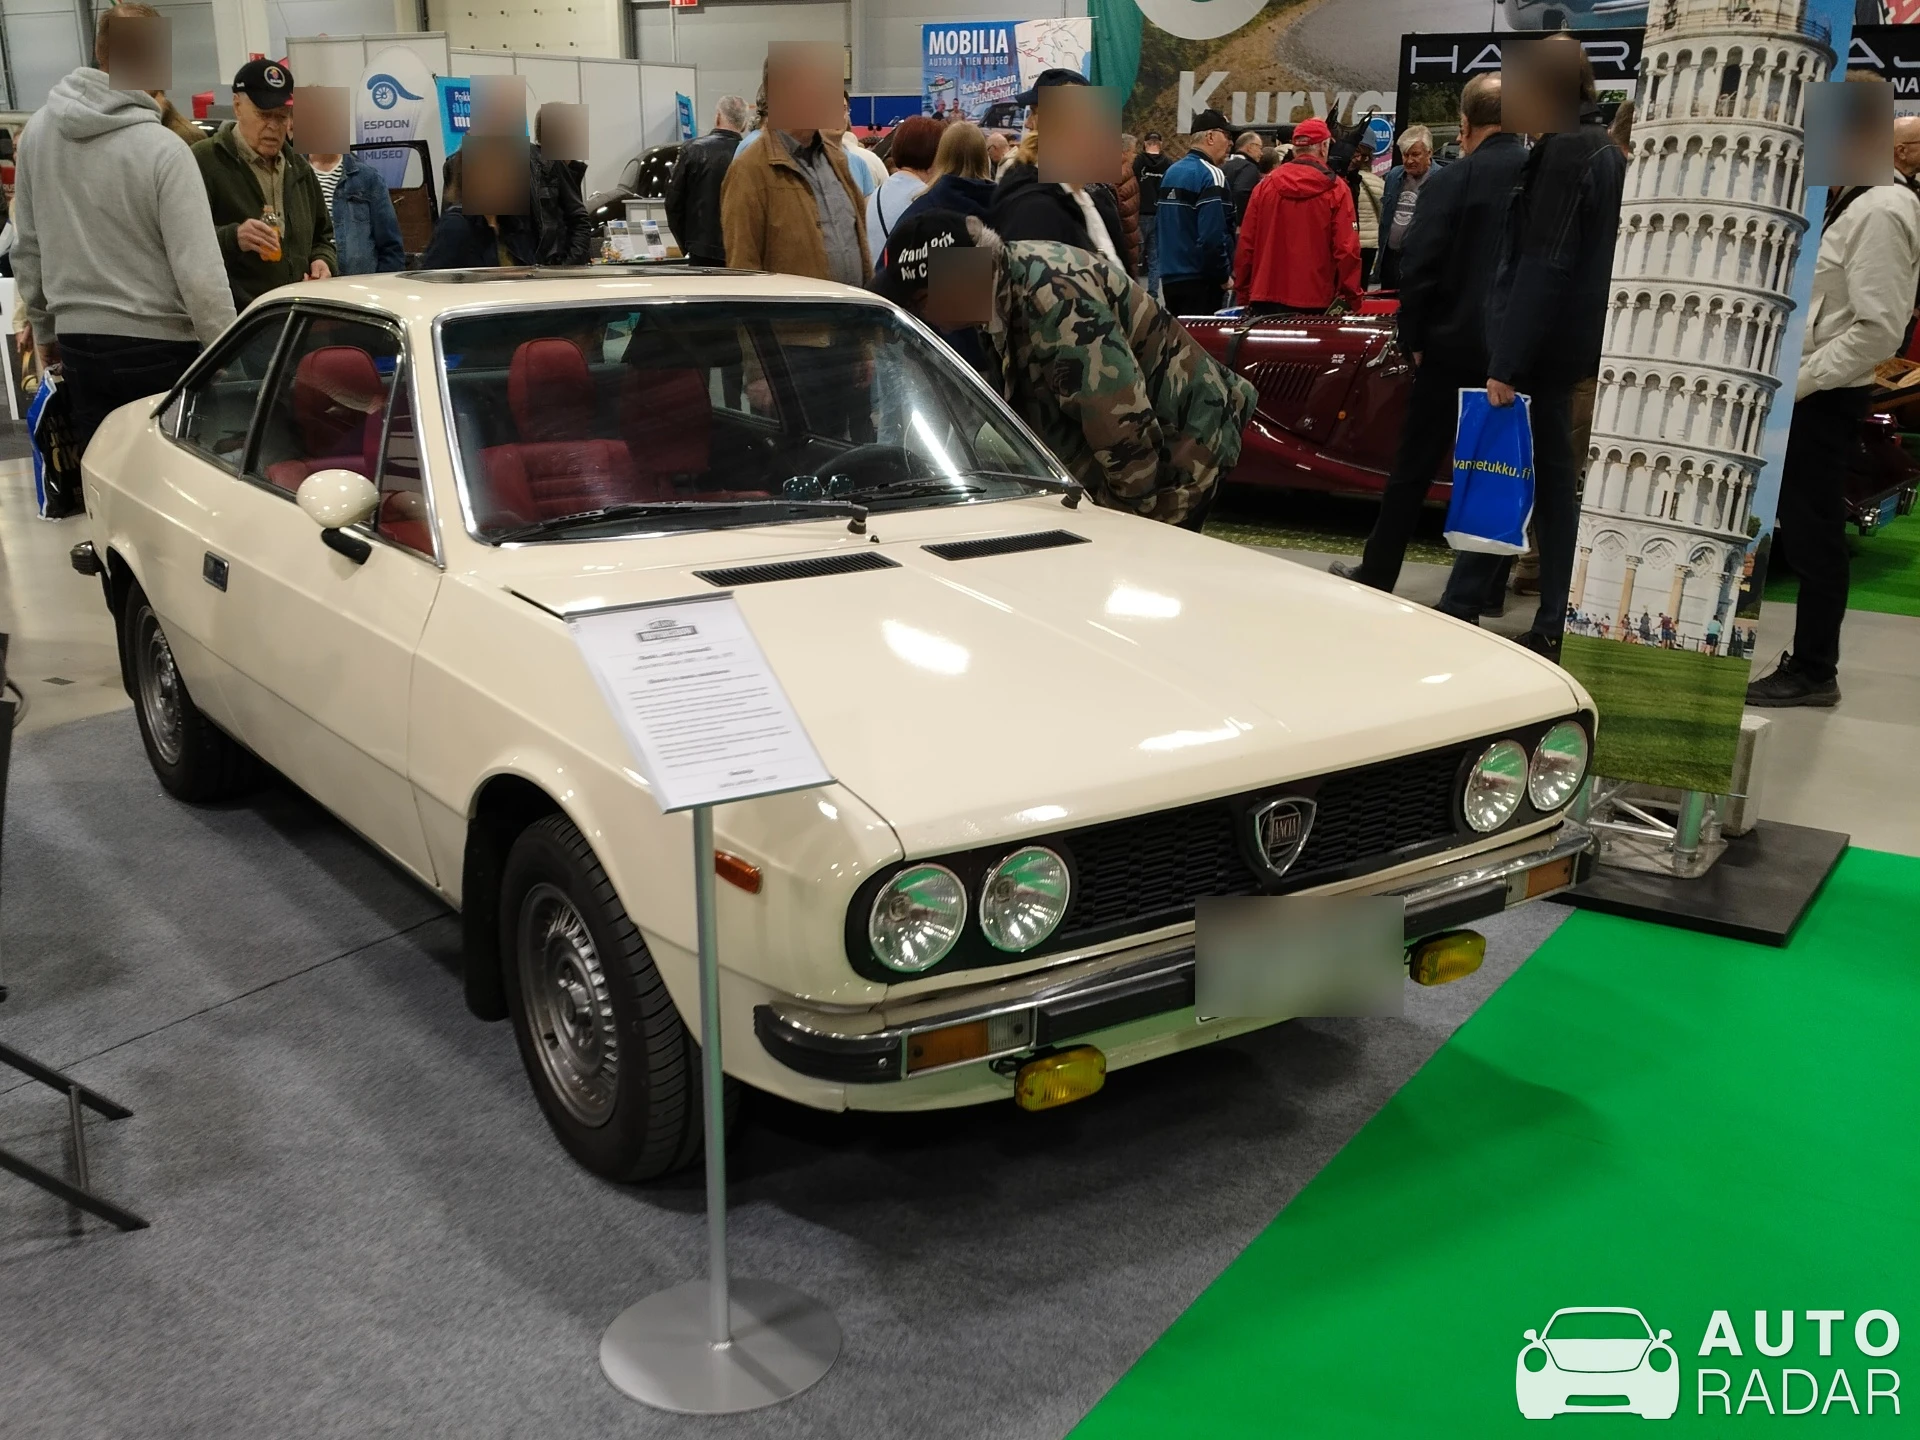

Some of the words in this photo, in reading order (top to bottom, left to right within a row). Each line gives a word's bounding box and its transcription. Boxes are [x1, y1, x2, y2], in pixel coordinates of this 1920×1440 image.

[929, 29, 1009, 55] MOBILIA
[929, 58, 952, 66] AUTON
[954, 57, 963, 65] JA
[965, 57, 982, 65] TIEN
[983, 55, 1009, 65] MUSEO
[984, 74, 1017, 92] perheen
[364, 119, 410, 130] ESPOON
[364, 135, 393, 144] AUTO
[364, 150, 403, 161] MUSEO
[898, 241, 928, 264] Grand
[900, 265, 916, 281] Air
